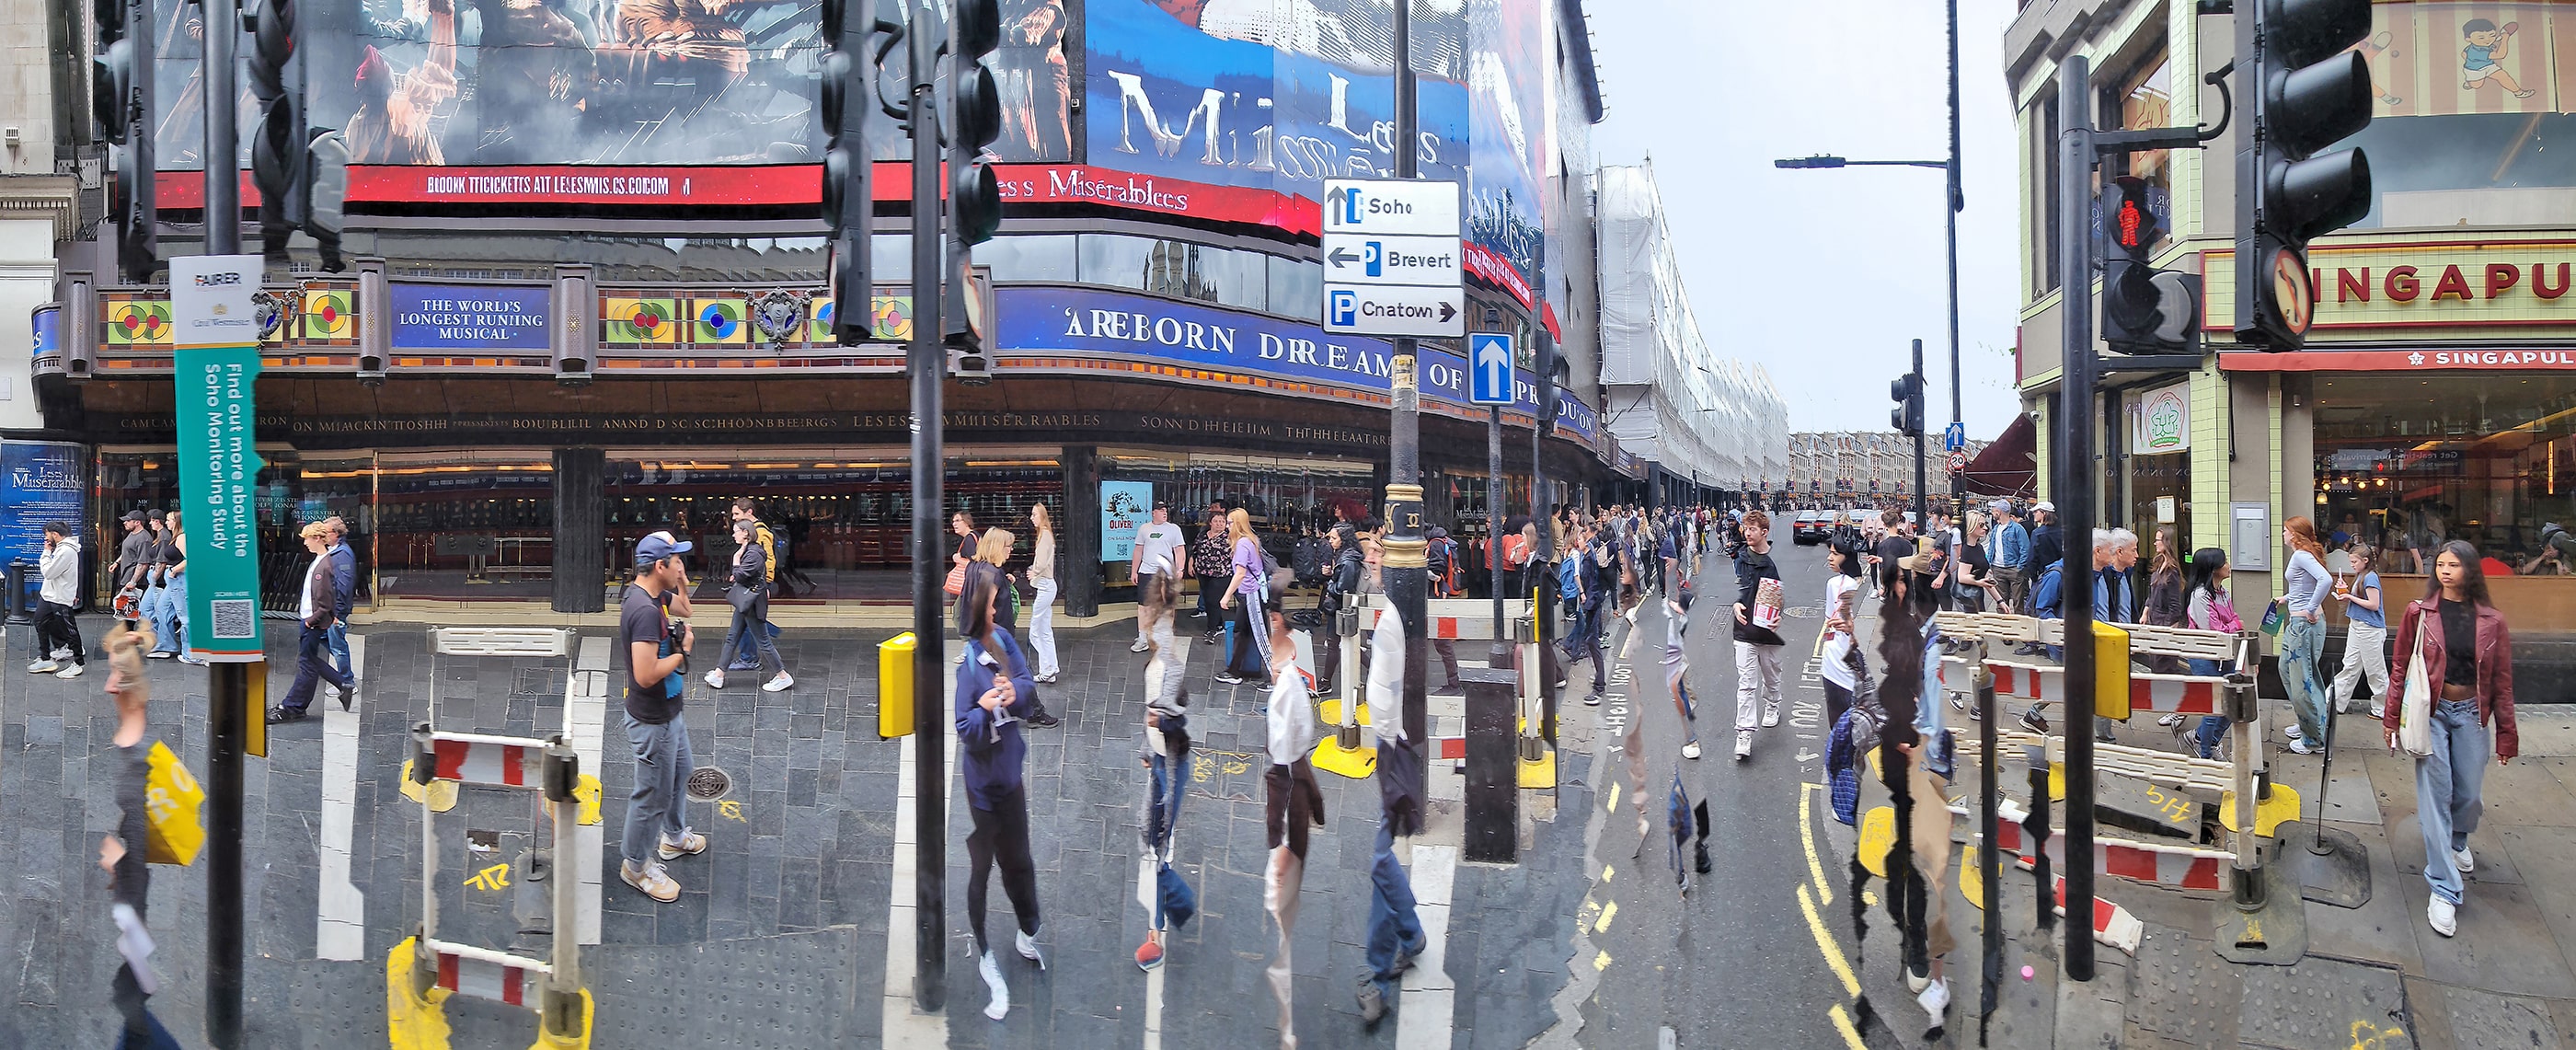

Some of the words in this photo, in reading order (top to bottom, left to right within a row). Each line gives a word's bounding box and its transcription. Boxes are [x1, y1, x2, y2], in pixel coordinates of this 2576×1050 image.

[1368, 198, 1412, 214] Soho
[1387, 251, 1452, 269] Brevert
[2312, 262, 2571, 304] INGAPU
[399, 313, 471, 326] LONGEST
[421, 299, 453, 312] THE
[439, 327, 510, 340] MUSICAL
[204, 363, 223, 408] Soho
[226, 363, 244, 398] Find
[1428, 363, 1464, 391] OF
[227, 403, 244, 433] out
[207, 412, 227, 505] Monitoring
[228, 436, 245, 480] more
[1951, 456, 1964, 465] 20
[231, 485, 247, 530] about
[210, 508, 229, 550] Study
[1110, 519, 1133, 530] OLIVER!
[234, 534, 250, 558] the
